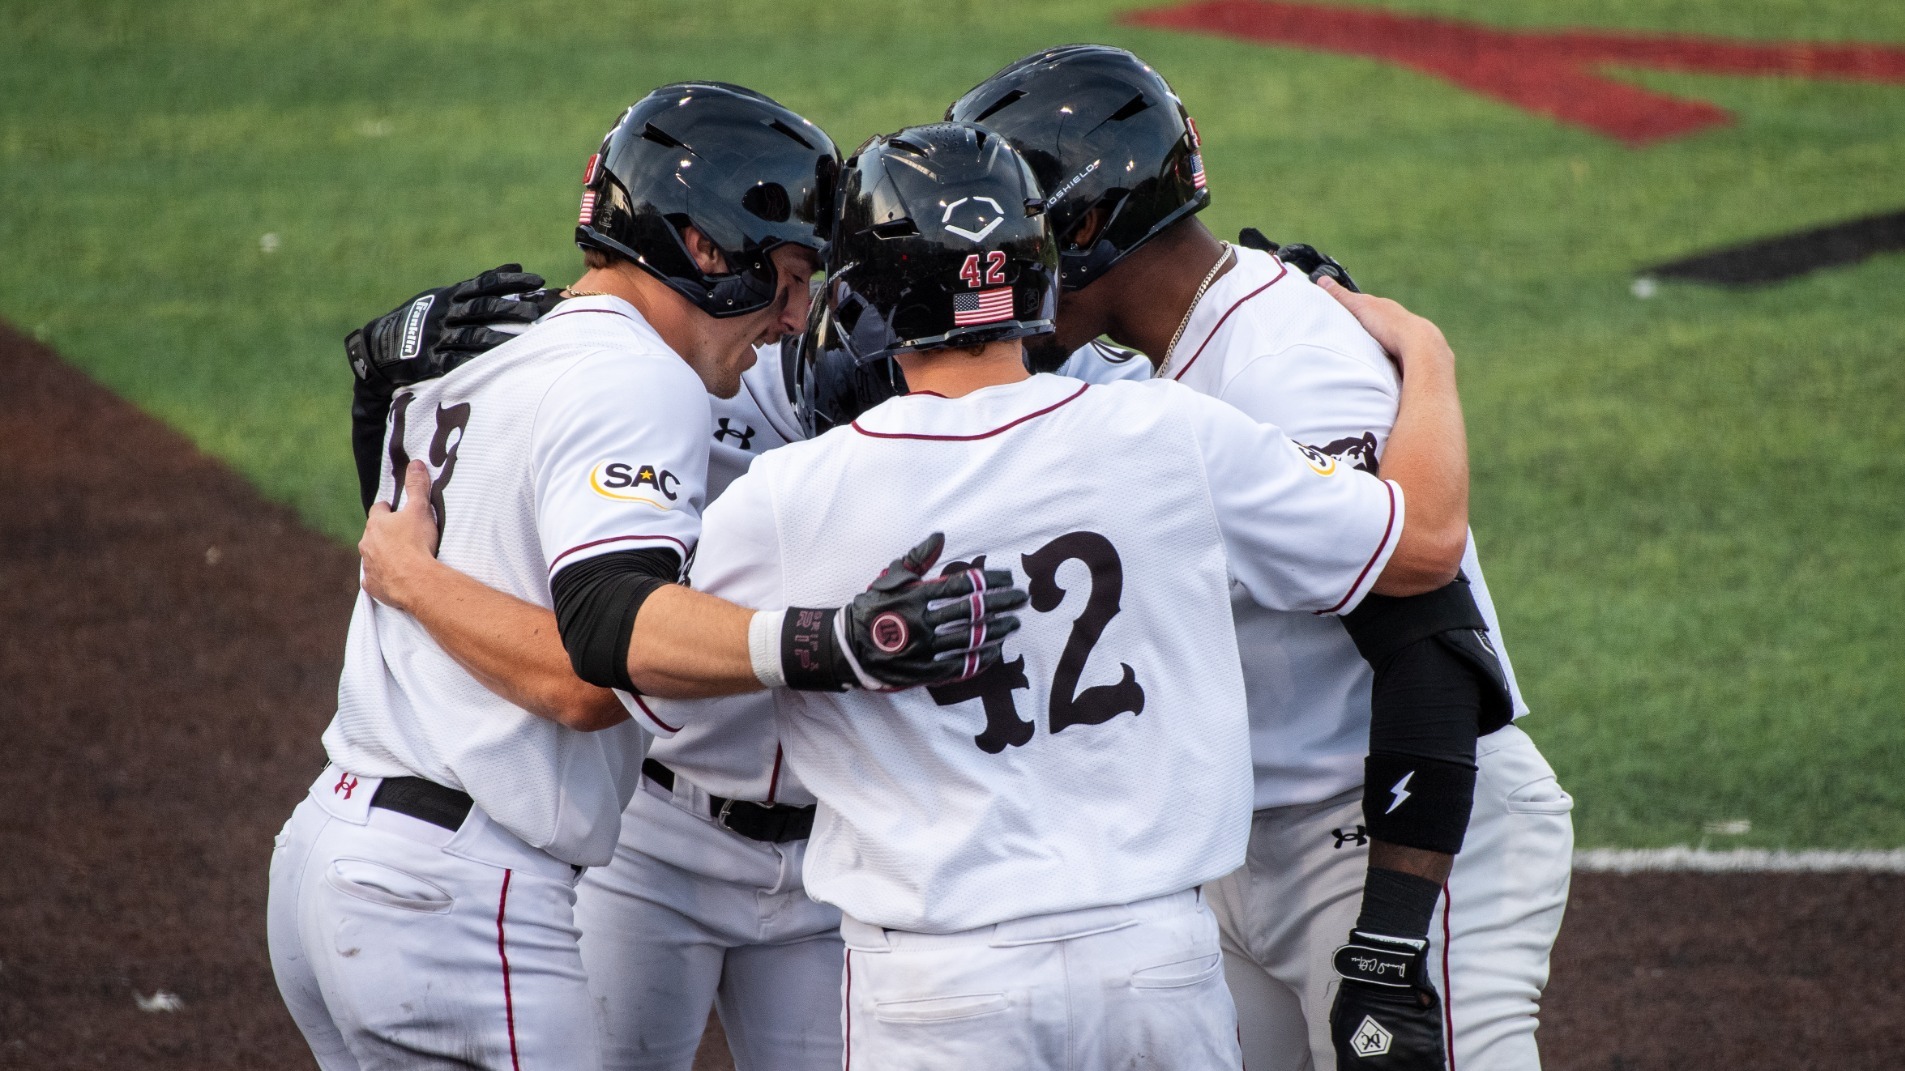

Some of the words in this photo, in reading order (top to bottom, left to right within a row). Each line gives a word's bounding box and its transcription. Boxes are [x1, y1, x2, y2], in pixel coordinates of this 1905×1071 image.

[1047, 163, 1095, 208] OSHIELD
[959, 251, 1006, 288] 42
[404, 301, 429, 354] Franklin
[603, 463, 681, 501] SAC
